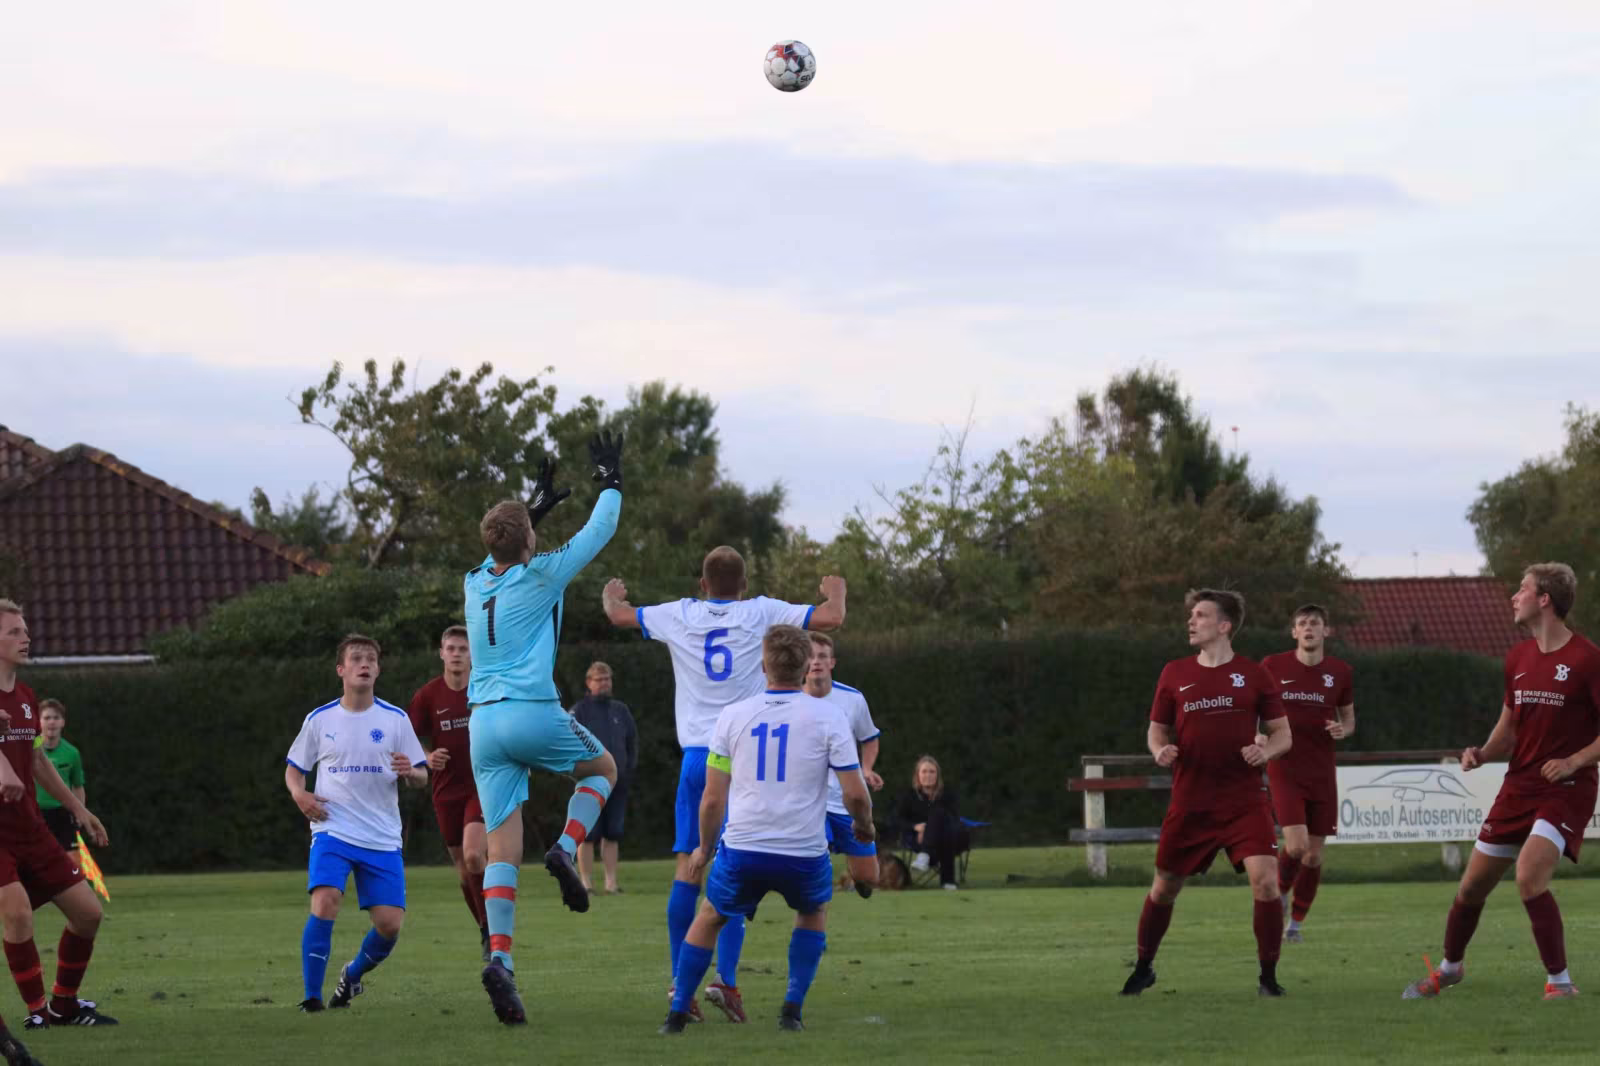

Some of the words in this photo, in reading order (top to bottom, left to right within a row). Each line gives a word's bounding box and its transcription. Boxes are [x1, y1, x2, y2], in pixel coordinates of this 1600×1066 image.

[482, 595, 496, 646] 1
[704, 628, 732, 682] 6
[1183, 696, 1233, 712] danbolig
[1282, 691, 1325, 703] danbolig
[751, 722, 789, 782] 11
[340, 765, 361, 773] AUTO
[1399, 802, 1483, 826] Autoservice
